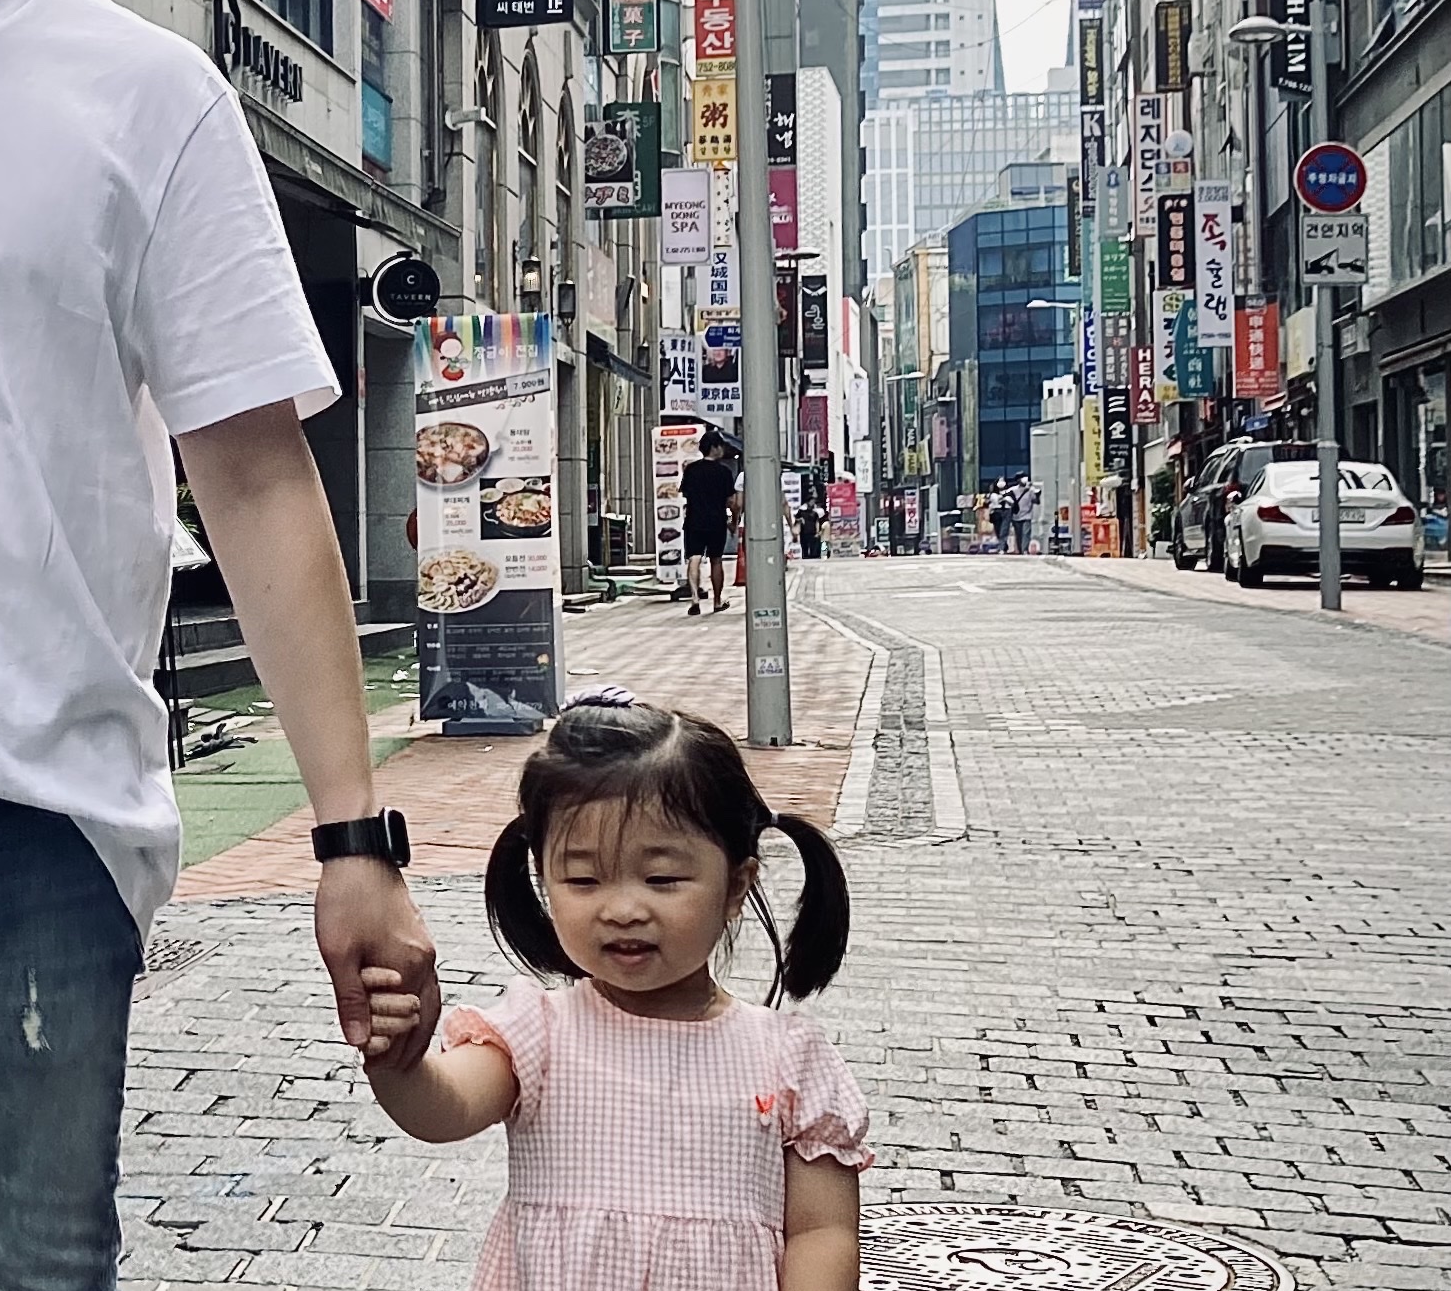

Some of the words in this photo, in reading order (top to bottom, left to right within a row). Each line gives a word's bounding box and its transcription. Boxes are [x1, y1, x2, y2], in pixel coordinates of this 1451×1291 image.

[701, 101, 729, 129] 粥
[1306, 171, 1358, 185] 주정차금지
[665, 200, 706, 210] MYEONG
[670, 211, 700, 220] DONG
[671, 221, 700, 233] SPA
[1306, 222, 1365, 239] 견인지역
[1138, 348, 1152, 403] HERA
